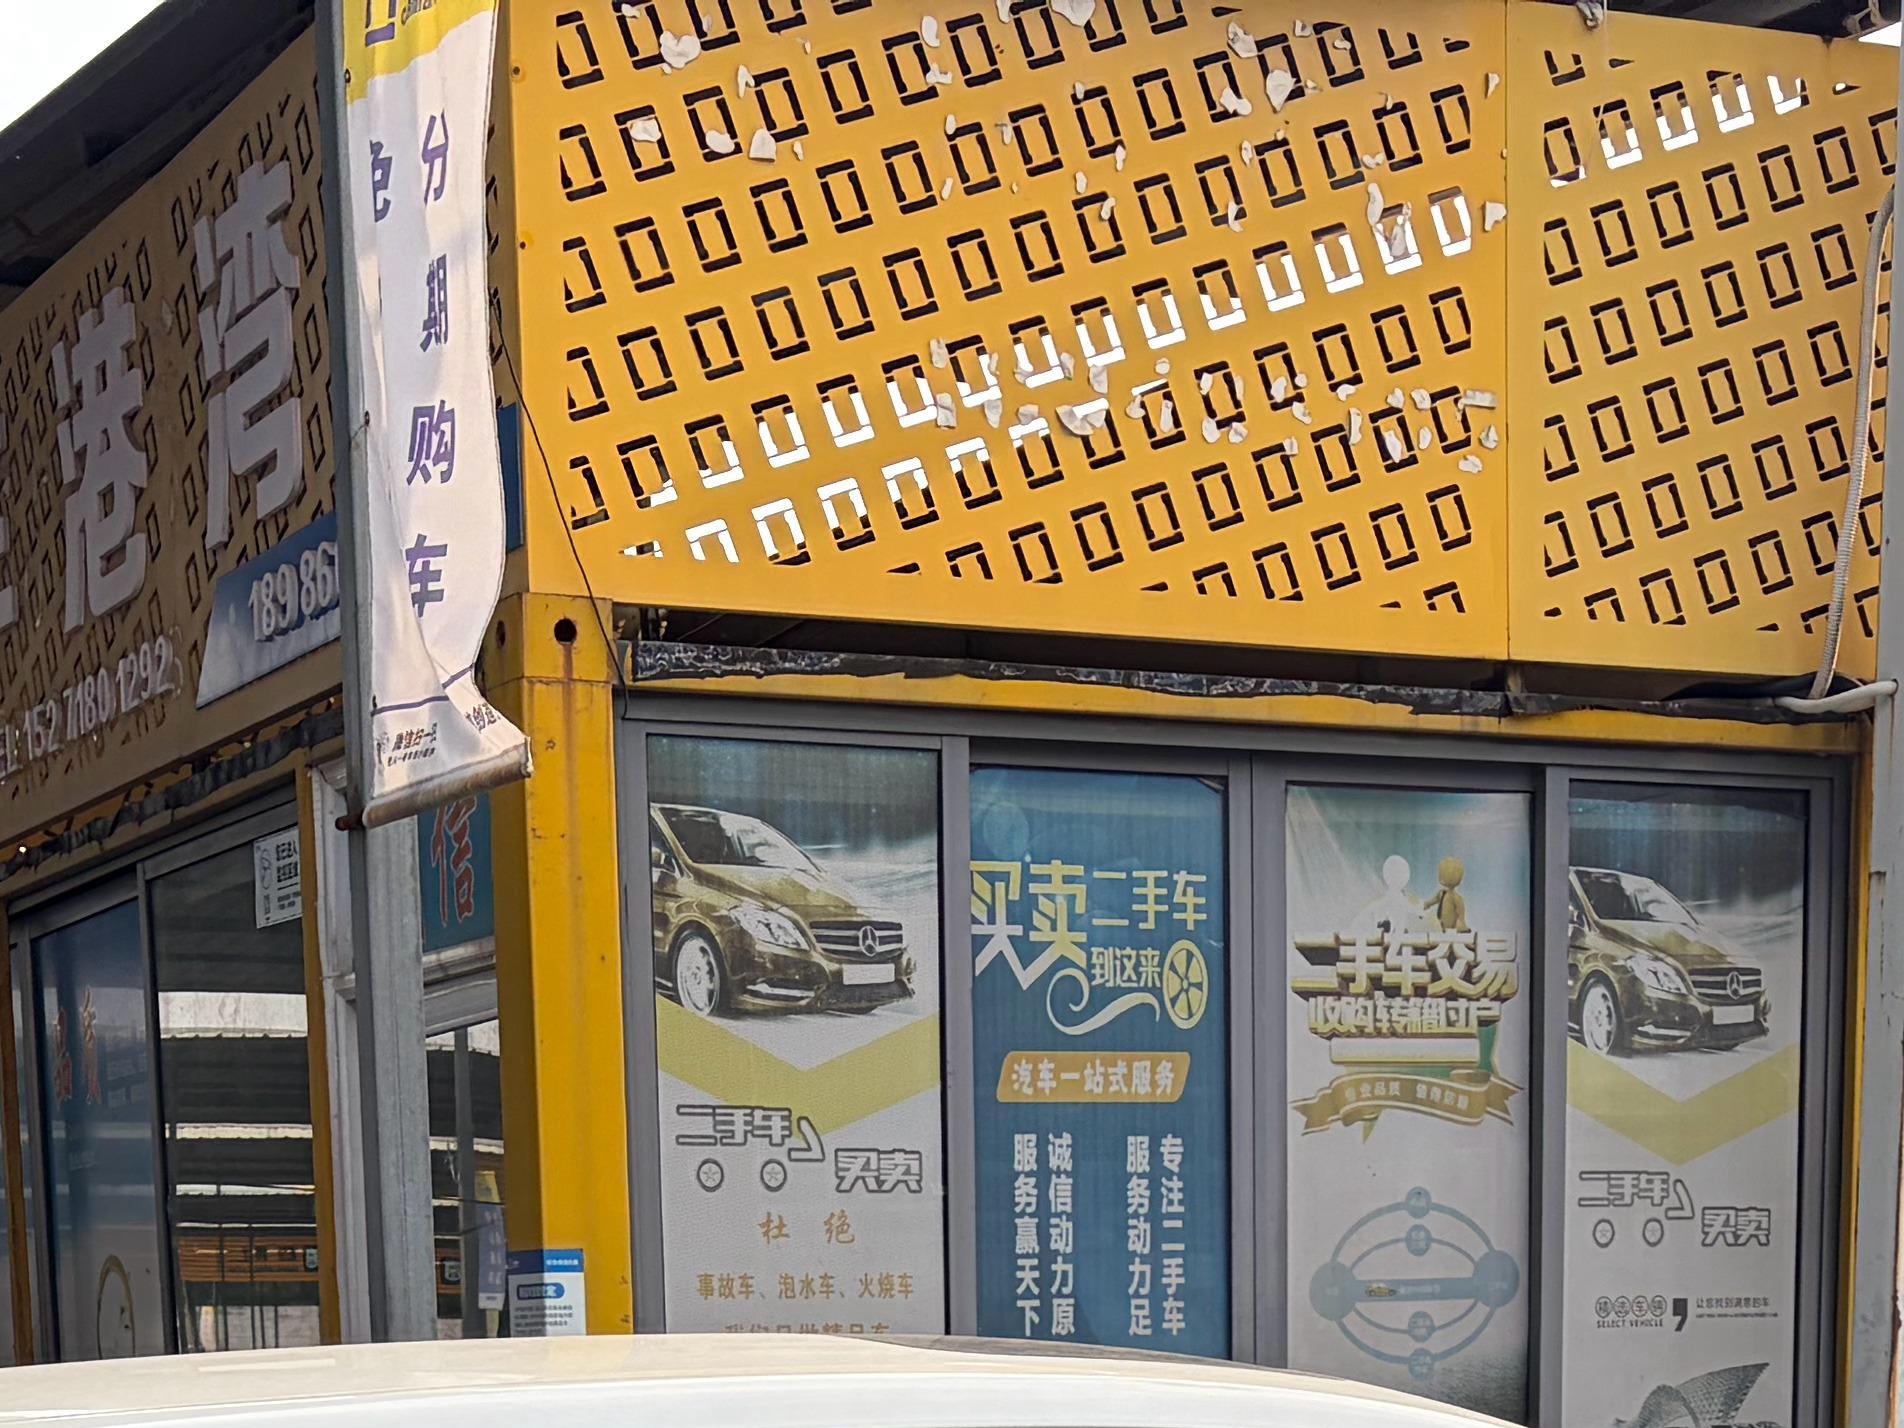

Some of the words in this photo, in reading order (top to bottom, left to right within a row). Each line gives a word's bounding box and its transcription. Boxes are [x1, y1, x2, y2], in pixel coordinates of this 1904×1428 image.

[405, 108, 456, 619] 分期购车
[248, 563, 298, 641] 189
[299, 540, 341, 616] 86
[23, 698, 64, 762] 152
[63, 667, 116, 742] 7180
[115, 634, 176, 714] 1292
[970, 860, 1088, 991] 买卖
[1092, 869, 1208, 931] 二手车
[1090, 945, 1162, 988] 到这来
[1291, 930, 1520, 999] 二手车交易
[1010, 1058, 1175, 1097] 汽车一站式服务
[676, 1104, 793, 1147] 二手车
[834, 1148, 923, 1193] 买卖
[1578, 1170, 1671, 1208] 二手车
[757, 1209, 856, 1245] 杜绝
[1013, 1133, 1041, 1337] 服务赢天下
[1048, 1132, 1075, 1336] 诚信动力原
[1126, 1135, 1152, 1336] 服务动力足
[1159, 1133, 1186, 1336] 专注二手车
[1701, 1206, 1772, 1247] 买卖
[696, 1271, 915, 1301] 事故车、泡水车、火烧车
[1597, 1319, 1626, 1329] SELECT
